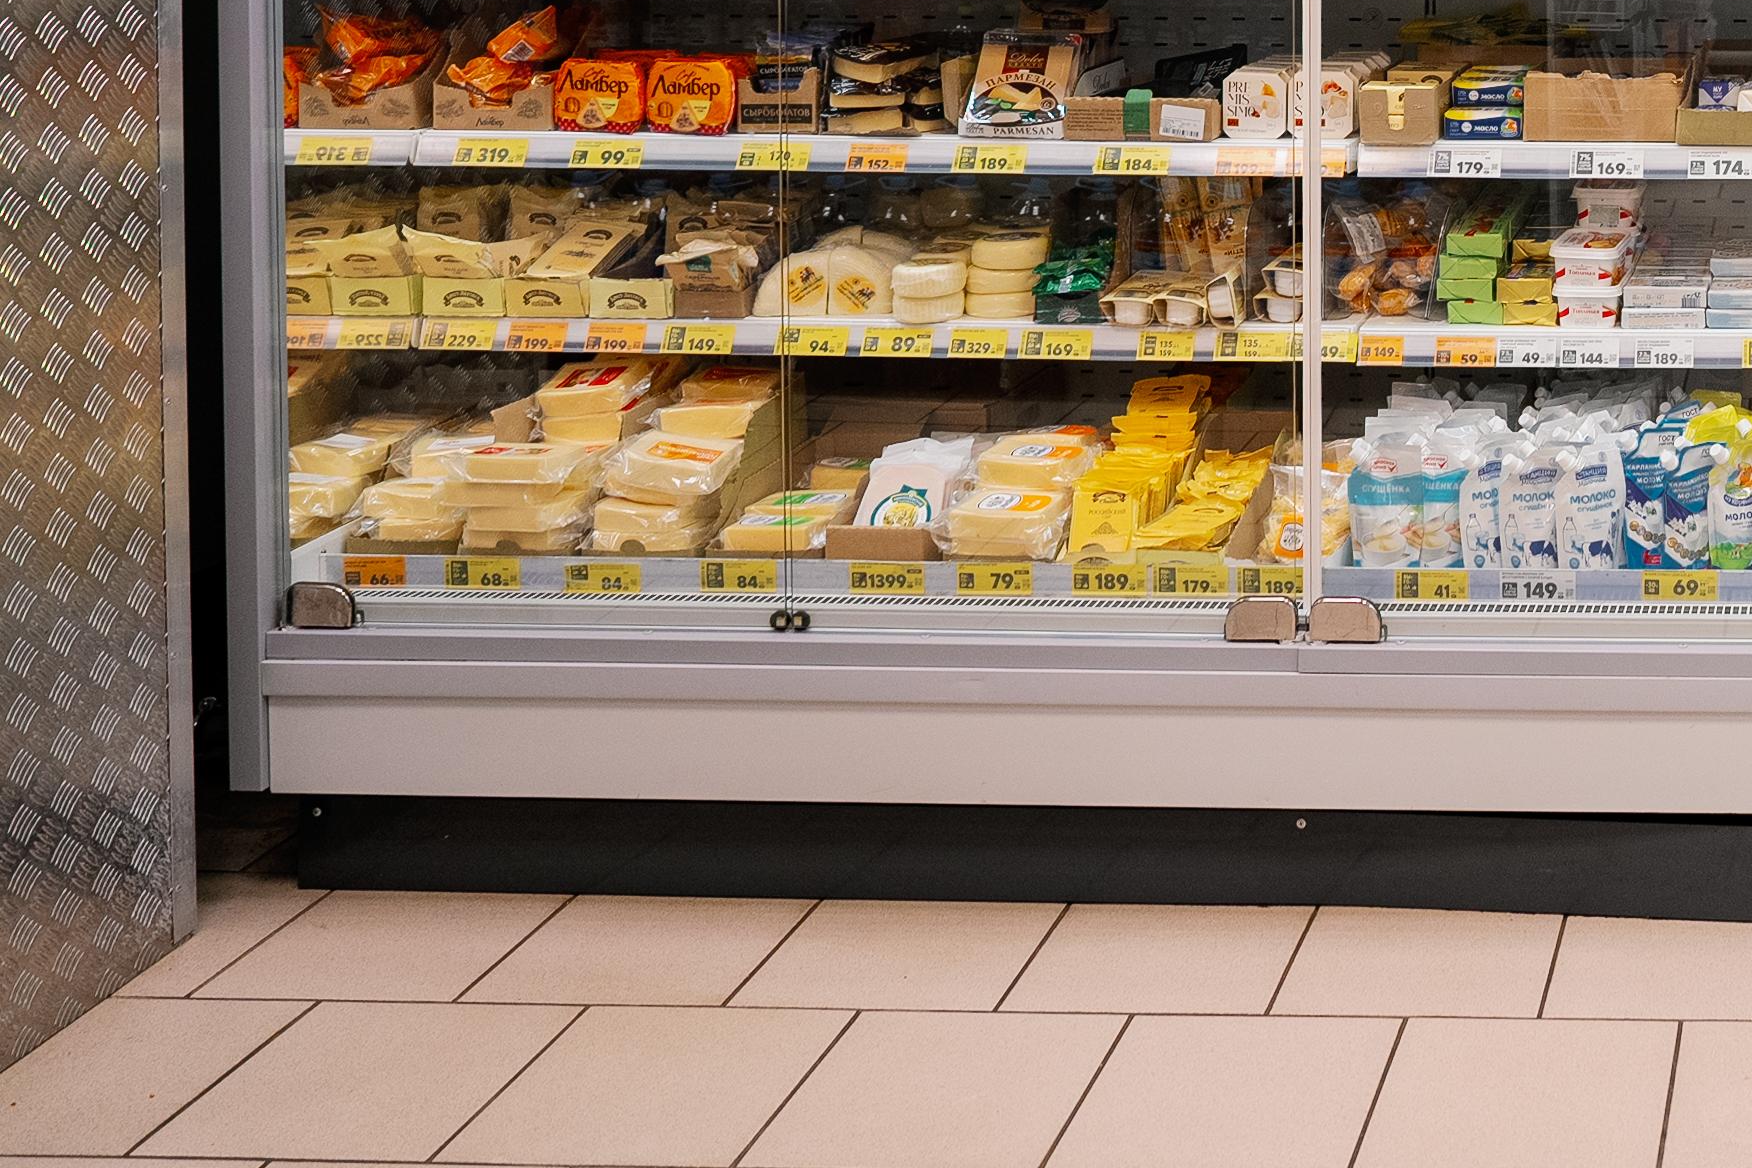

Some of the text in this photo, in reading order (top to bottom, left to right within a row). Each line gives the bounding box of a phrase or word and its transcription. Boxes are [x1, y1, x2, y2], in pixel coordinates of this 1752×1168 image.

[559, 70, 629, 98] Ламбер
[650, 70, 721, 97] Ламбер
[985, 72, 1057, 90] ПАРМЕЗАН
[993, 126, 1055, 136] PARMESAN
[476, 148, 509, 162] 319
[1124, 158, 1151, 171] 184
[1597, 162, 1626, 175] 169
[890, 336, 916, 353] 89
[1045, 342, 1074, 356] 169
[1653, 352, 1678, 365] 189
[1569, 488, 1616, 503] МОЛОКО
[1094, 572, 1128, 590] 189
[1673, 581, 1699, 595] 69
[1523, 582, 1557, 599] 149
